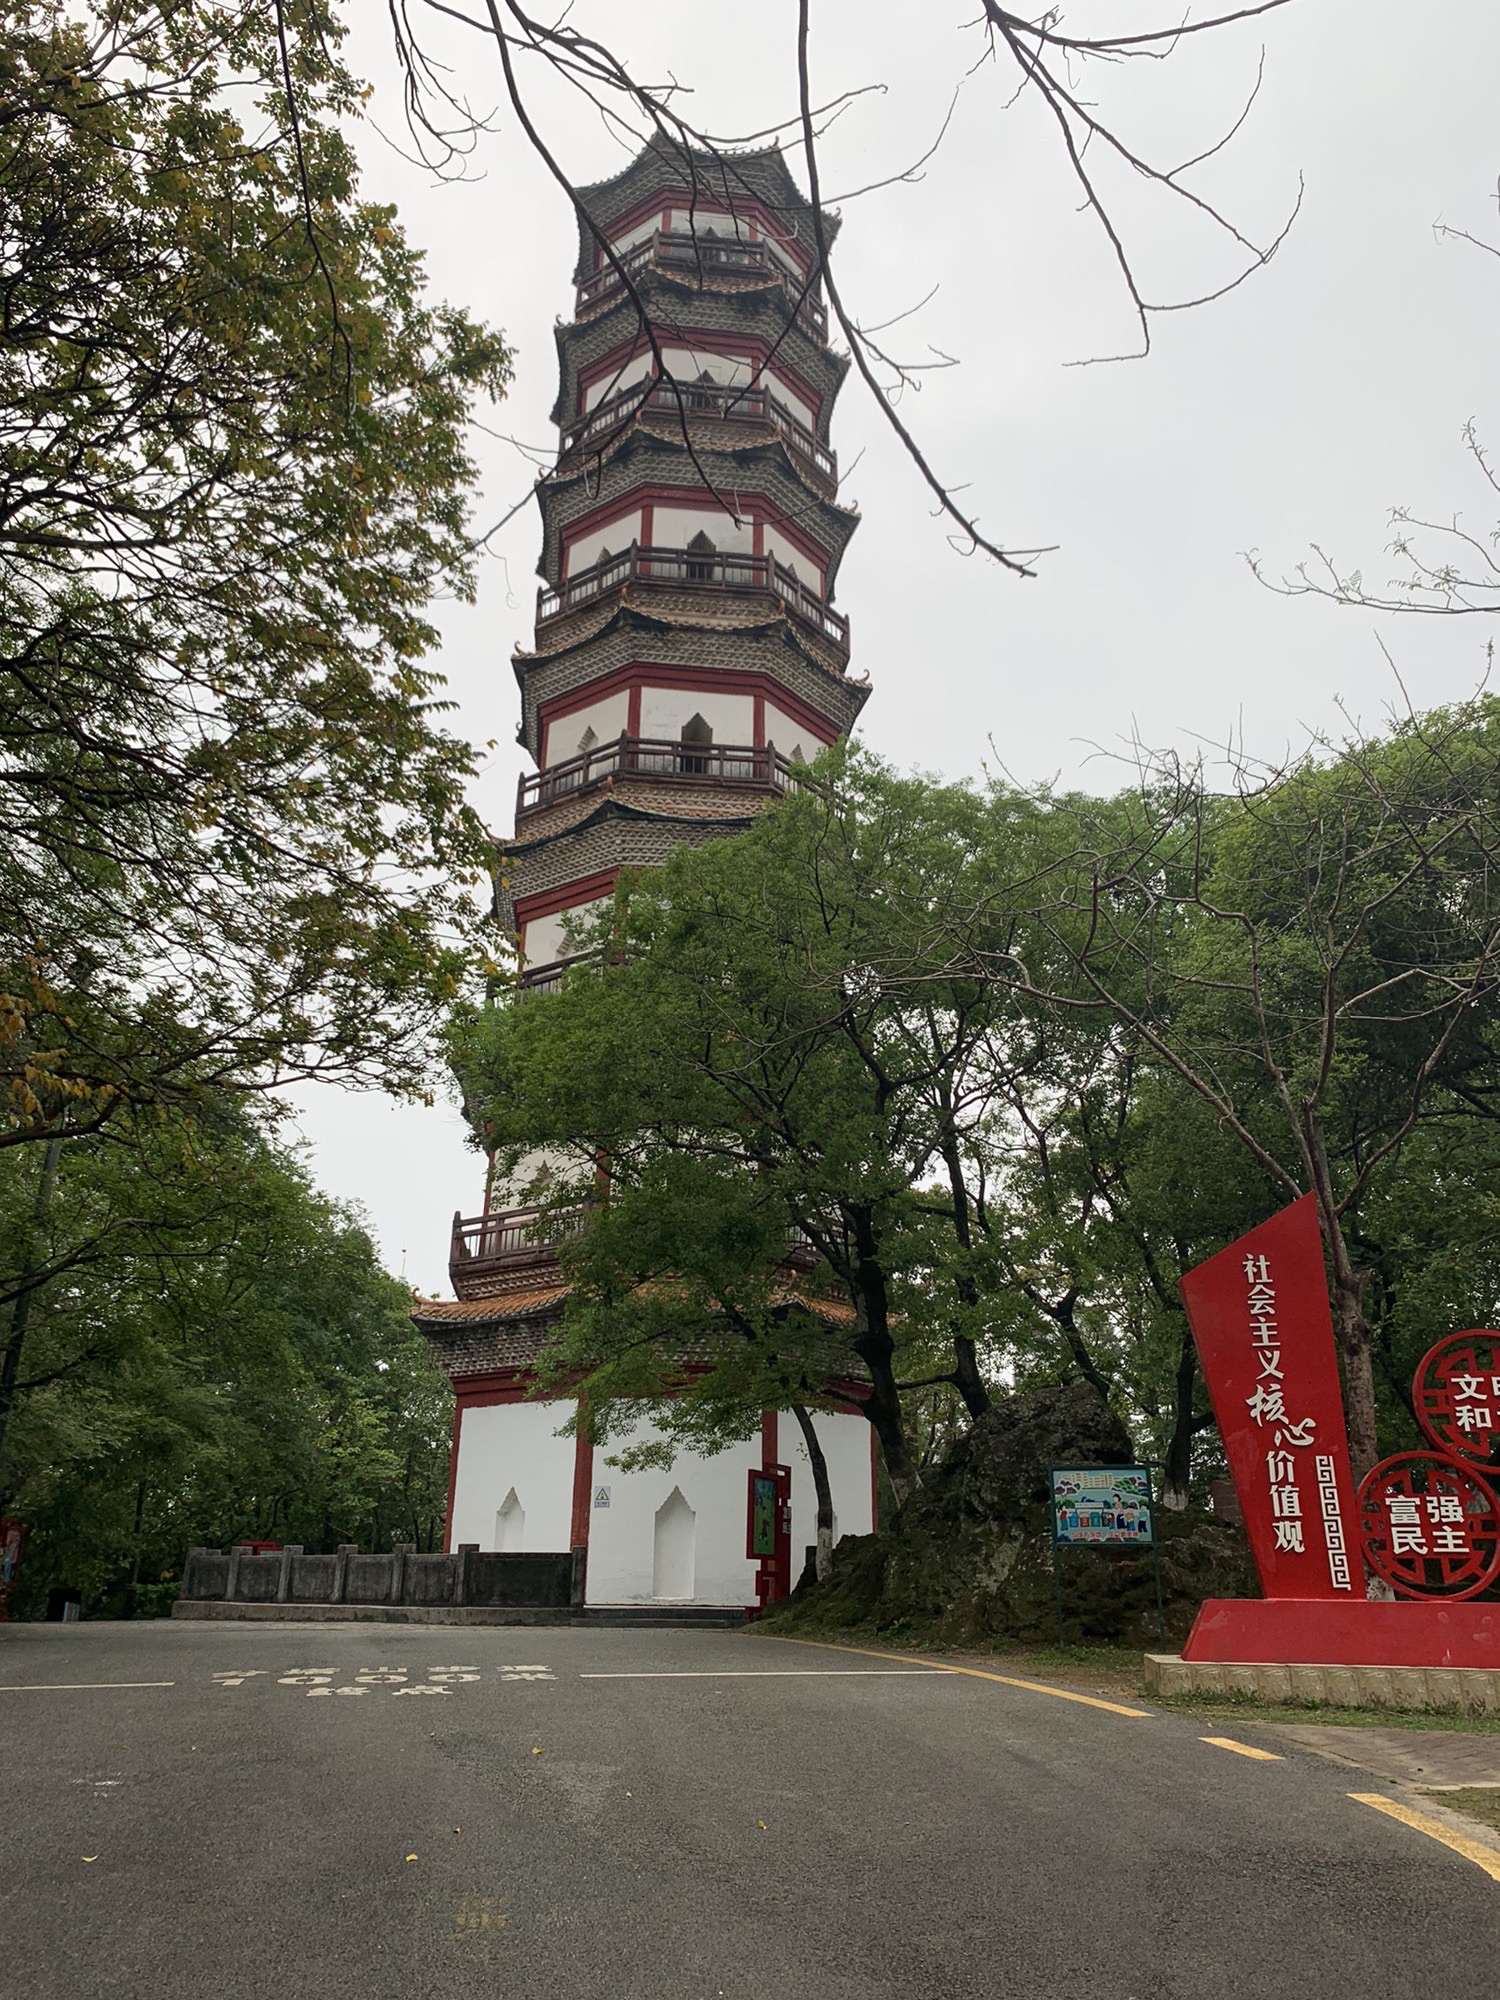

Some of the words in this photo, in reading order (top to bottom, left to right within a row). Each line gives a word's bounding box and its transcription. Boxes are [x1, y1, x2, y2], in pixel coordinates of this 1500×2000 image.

[1242, 1253, 1316, 1554] 社会主义核心价值观
[1454, 1405, 1500, 1432] 和
[1385, 1495, 1465, 1524] 富强
[1392, 1526, 1470, 1555] 民主
[210, 1672, 559, 1687] 1000米
